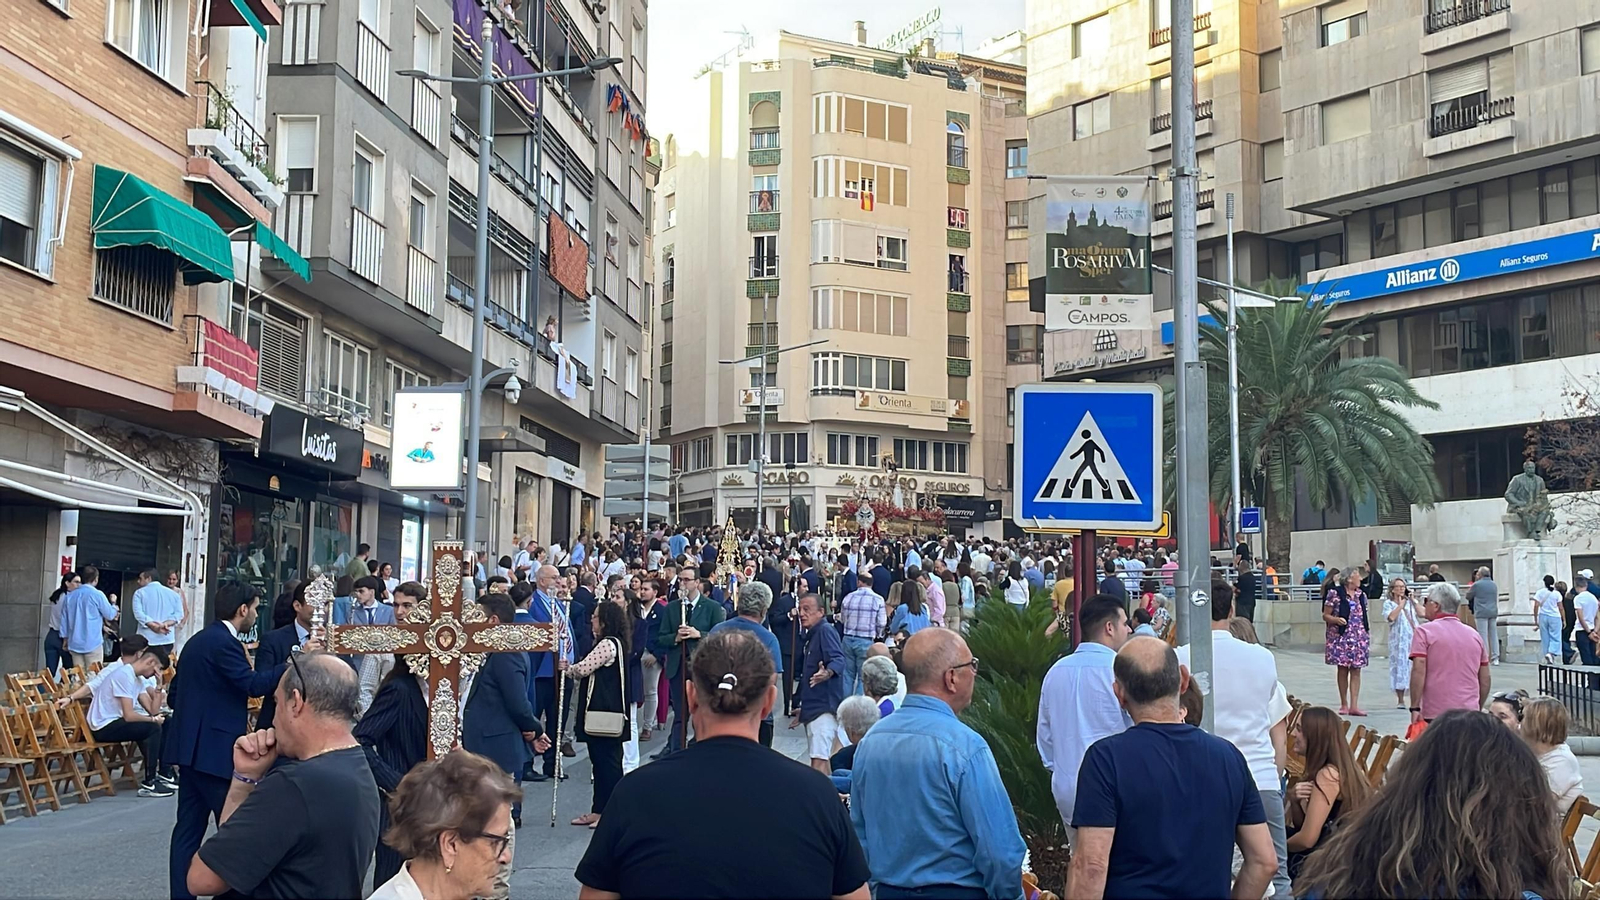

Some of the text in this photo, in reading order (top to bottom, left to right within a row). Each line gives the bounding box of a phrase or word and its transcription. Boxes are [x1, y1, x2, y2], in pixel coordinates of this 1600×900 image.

[1499, 252, 1549, 268] Allianz Seguros
[1385, 266, 1438, 289] Allianz
[1329, 289, 1351, 300] Seguros
[878, 395, 912, 408] Orienta
[301, 418, 337, 463] Luisitas
[924, 480, 970, 494] SEGUROS
